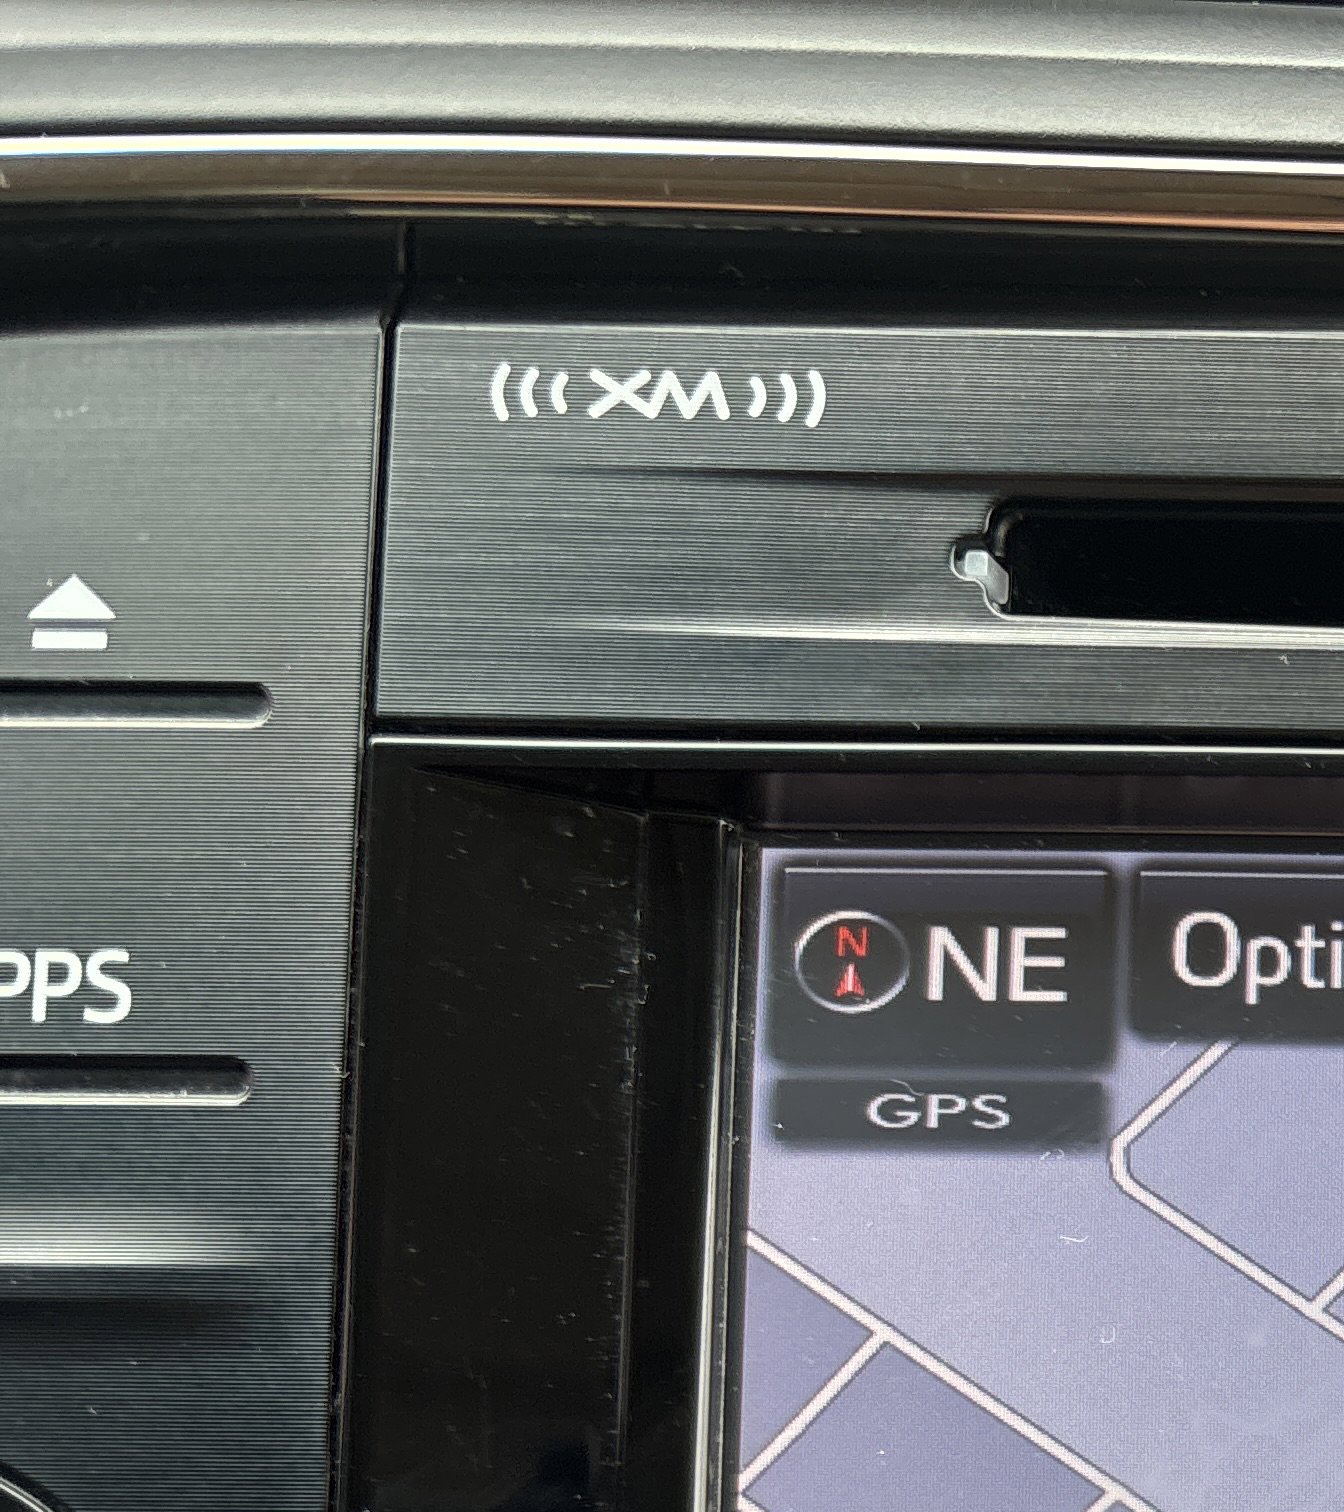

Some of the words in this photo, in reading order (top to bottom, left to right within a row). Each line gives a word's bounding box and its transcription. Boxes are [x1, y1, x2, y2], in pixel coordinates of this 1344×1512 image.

[837, 926, 868, 957] N
[928, 926, 1068, 1001] NE
[867, 1093, 1011, 1129] GPS
